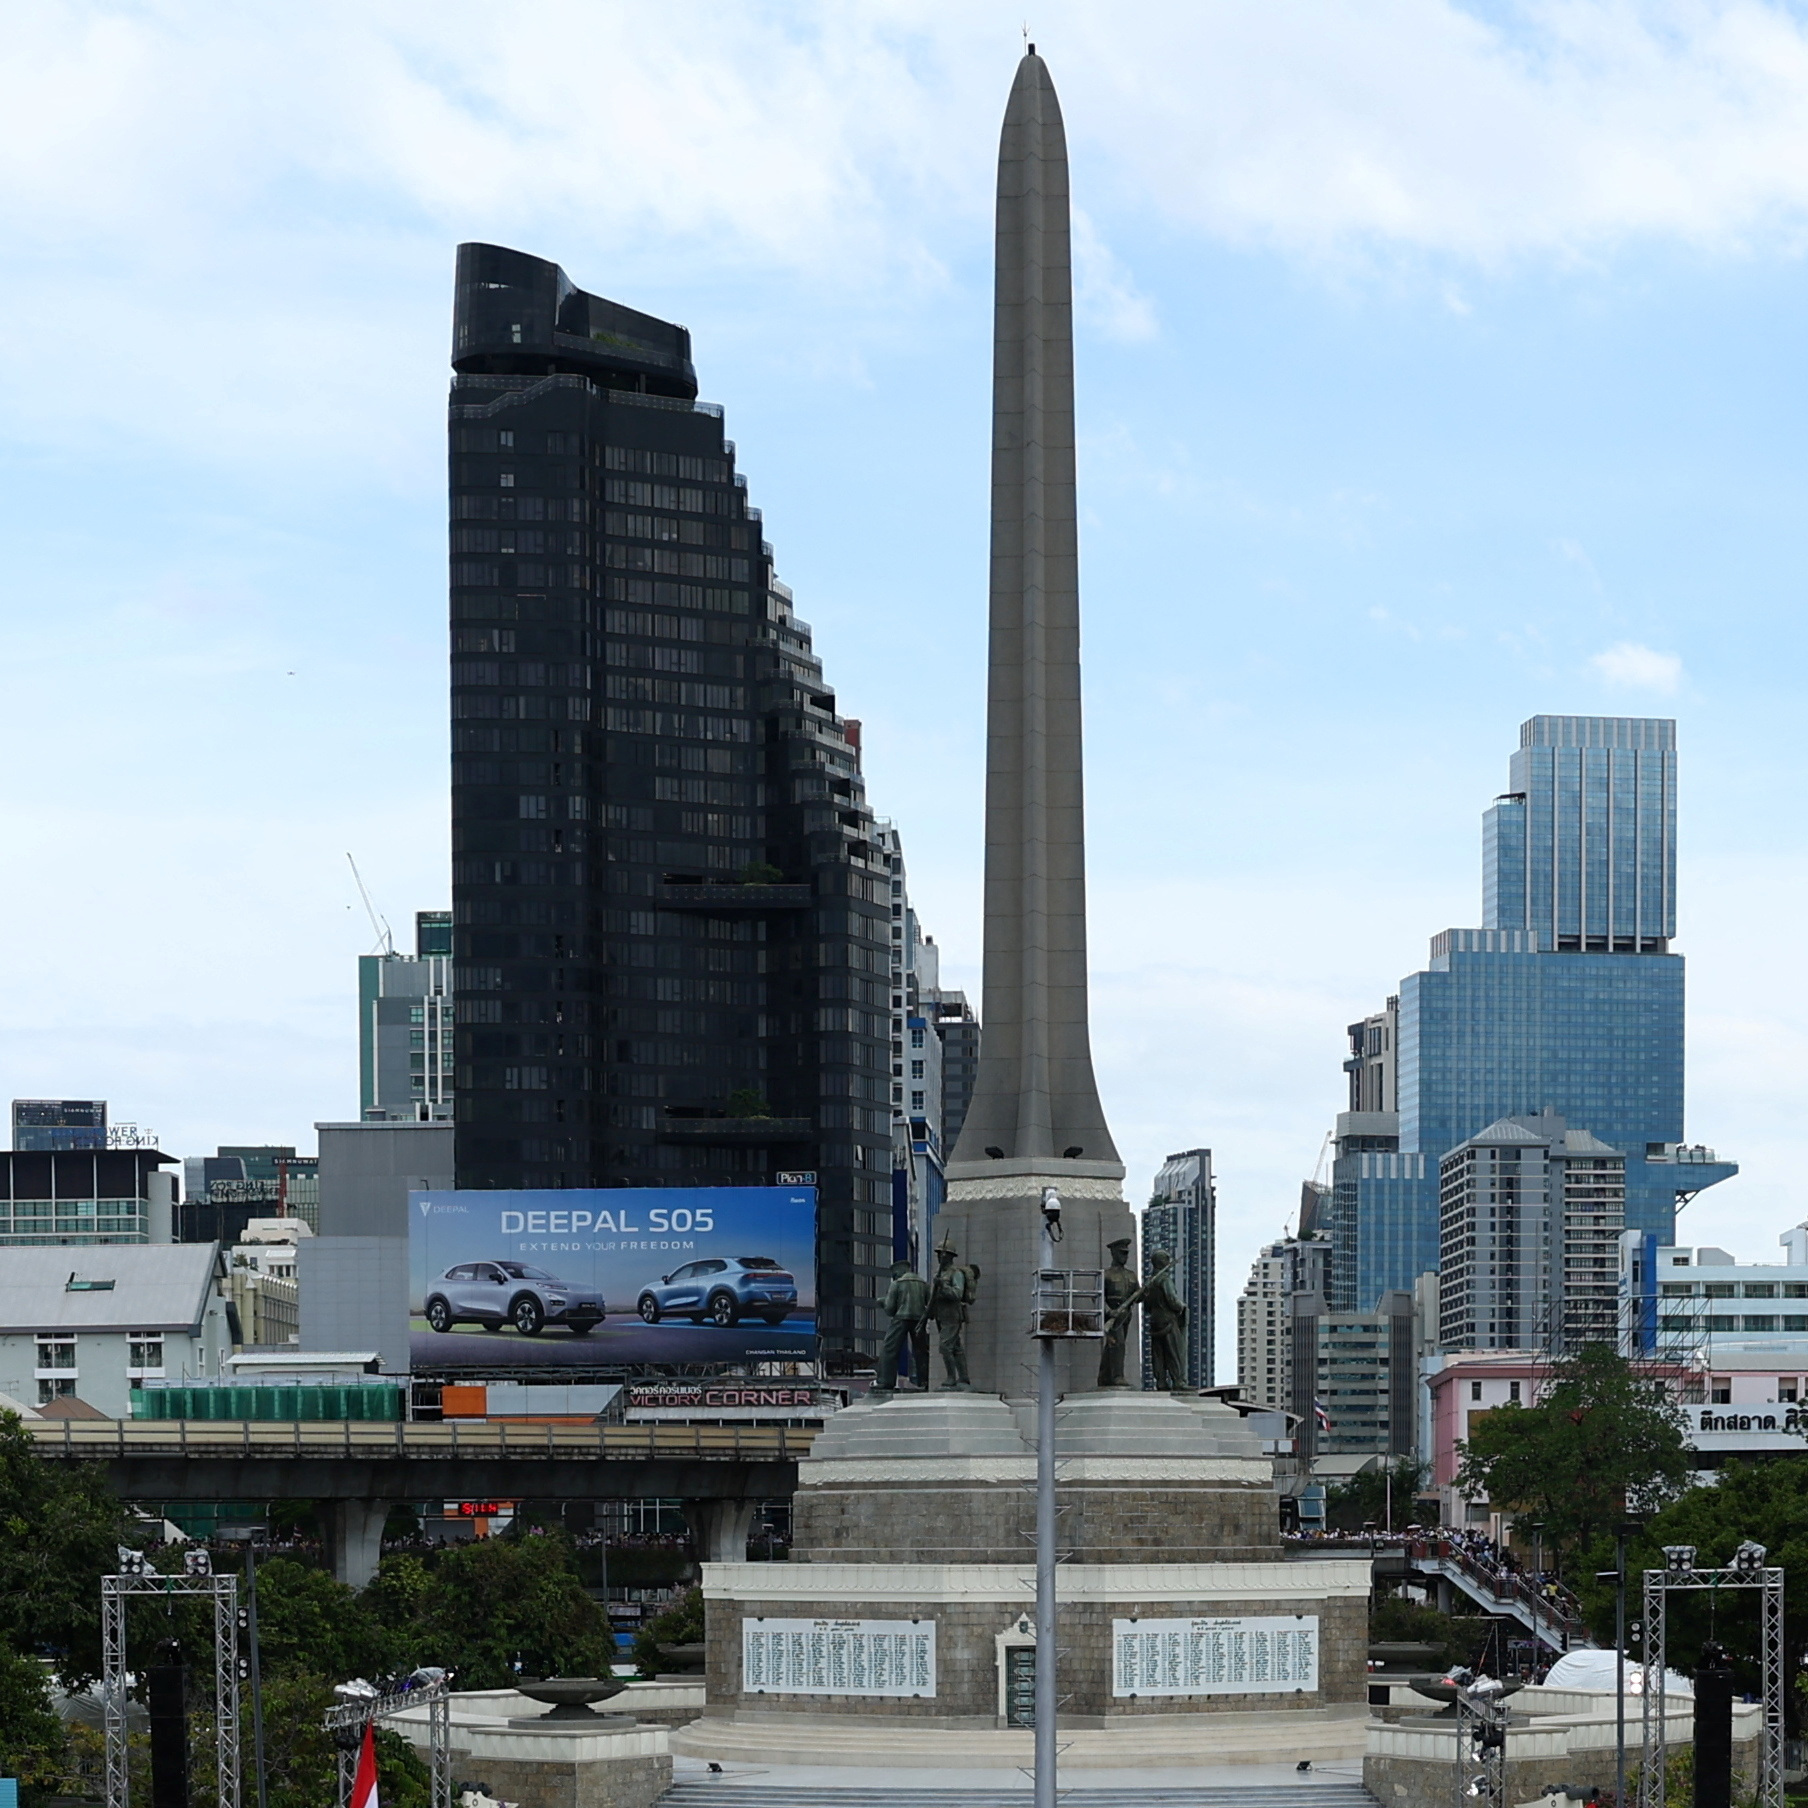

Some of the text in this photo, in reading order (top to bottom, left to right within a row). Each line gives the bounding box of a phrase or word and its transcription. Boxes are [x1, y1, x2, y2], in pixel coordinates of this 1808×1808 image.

[433, 1205, 469, 1214] DEEPAL
[500, 1208, 714, 1234] DEEPAL S05
[519, 1241, 695, 1251] EXTEND YOUR FREEDOM
[630, 1391, 812, 1407] VICTORY CORNER
[1699, 1407, 1776, 1430] ตึกสอาด
